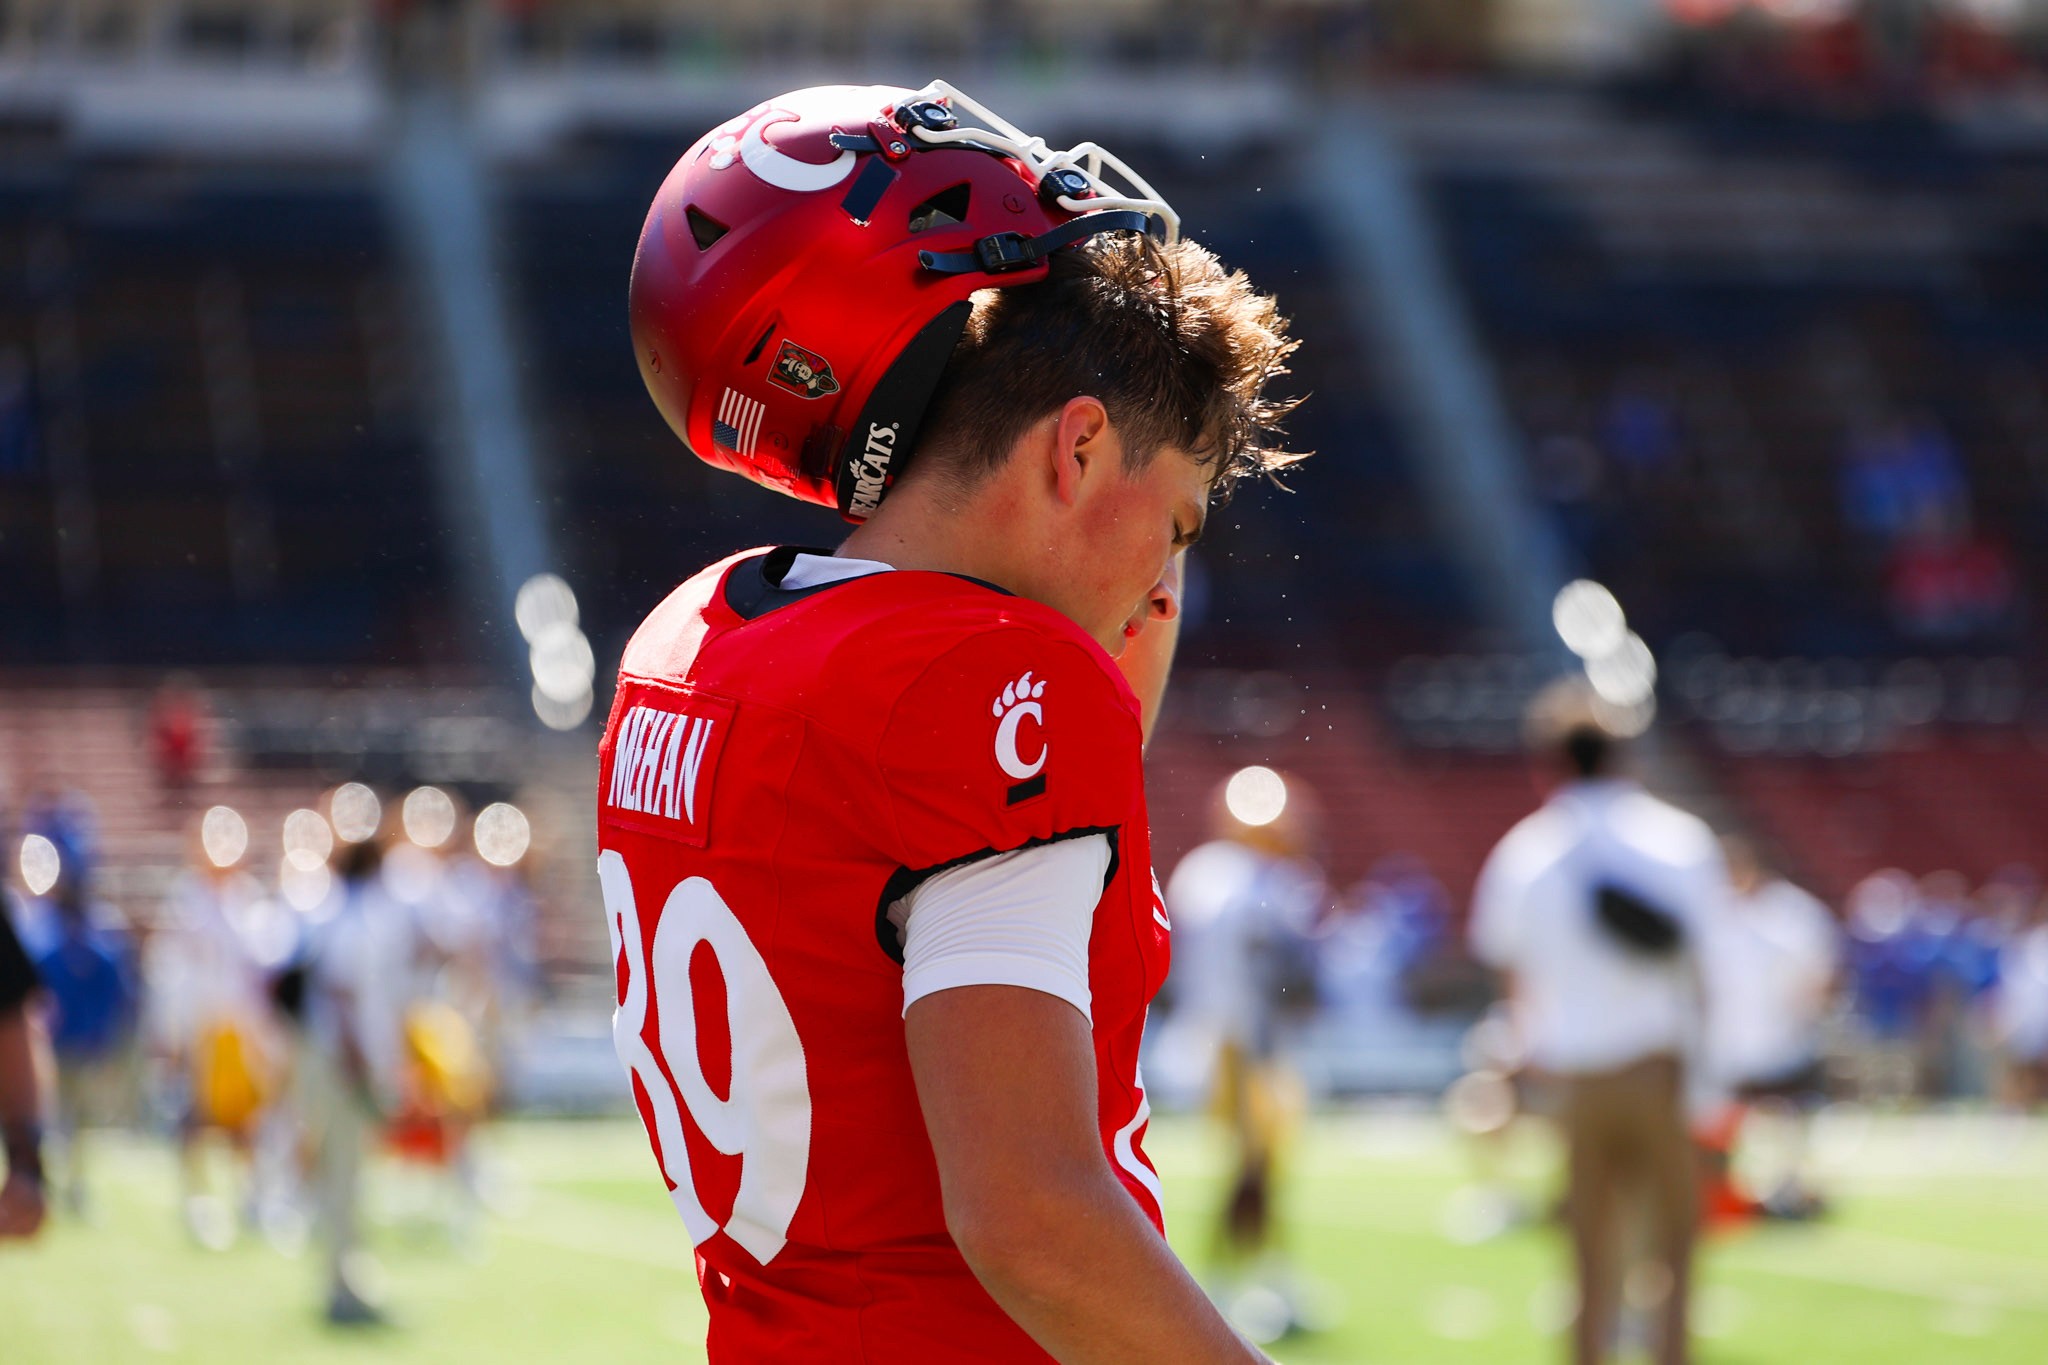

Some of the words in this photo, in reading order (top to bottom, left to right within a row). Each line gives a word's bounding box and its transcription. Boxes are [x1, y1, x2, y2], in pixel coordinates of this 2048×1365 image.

[607, 706, 714, 825] MEHAN
[994, 701, 1048, 779] C
[597, 848, 812, 1266] 89
